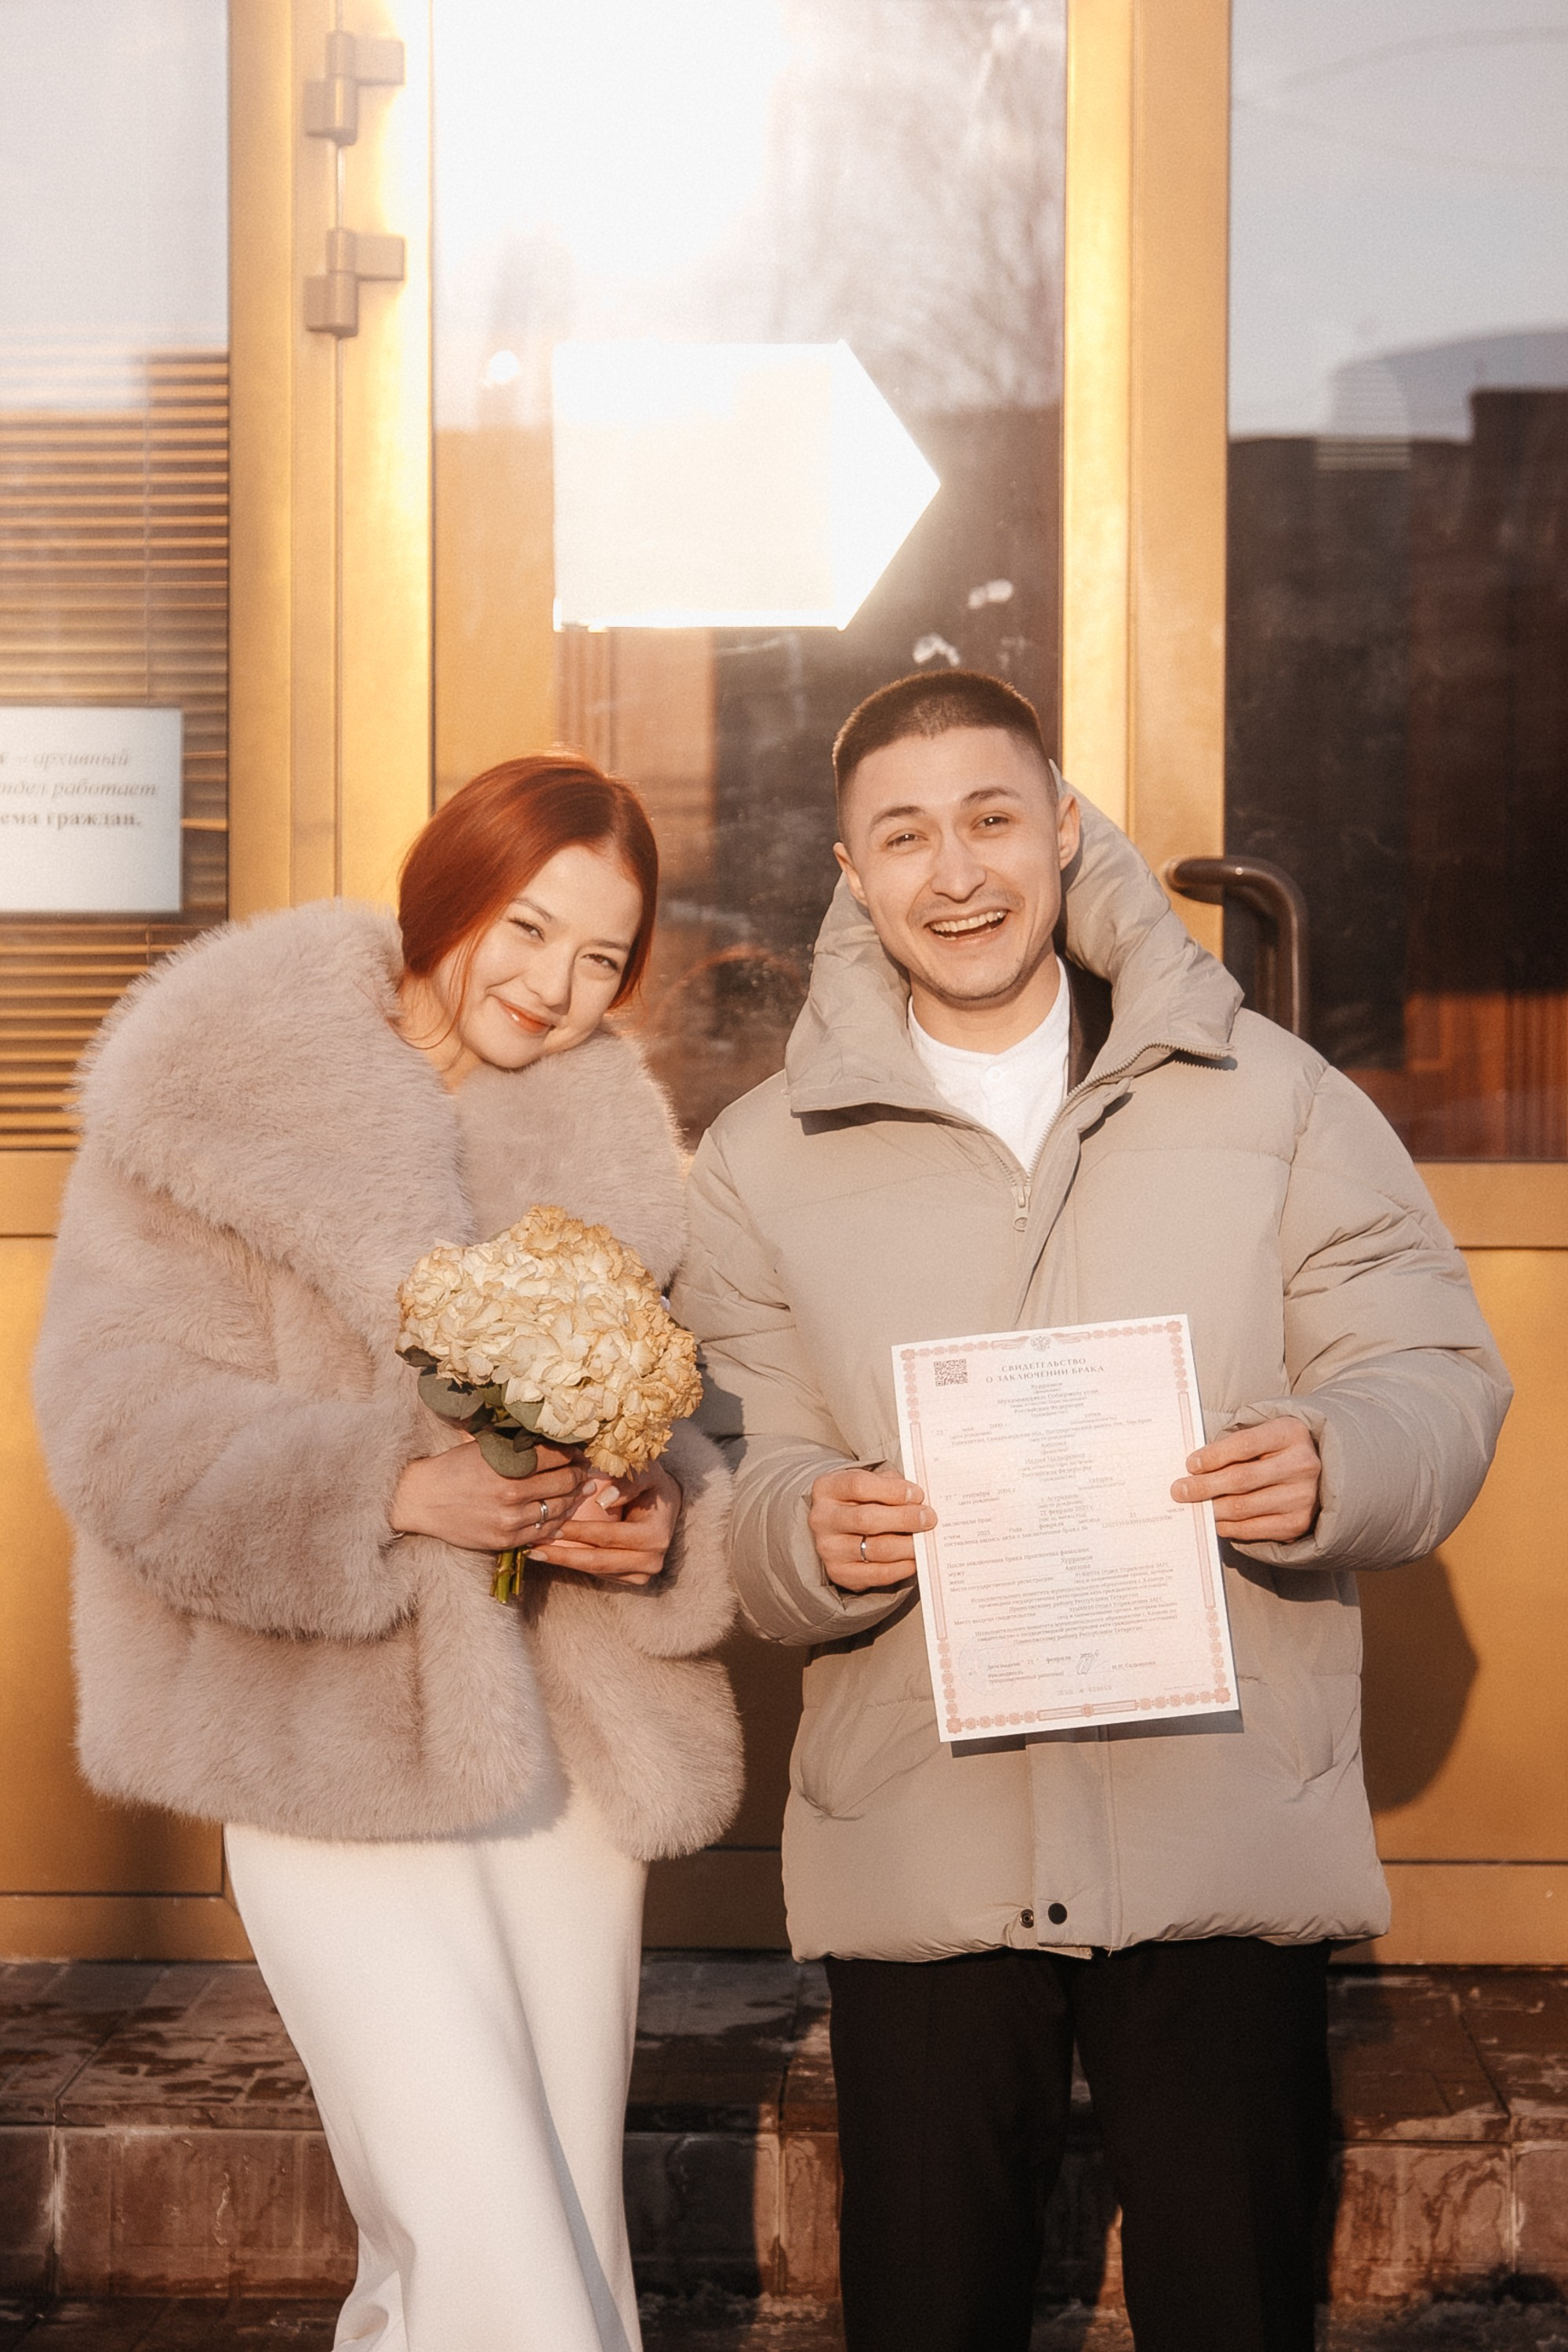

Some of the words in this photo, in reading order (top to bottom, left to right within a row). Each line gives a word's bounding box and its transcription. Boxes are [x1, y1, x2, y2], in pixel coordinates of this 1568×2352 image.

[52, 778, 157, 800] работает
[45, 811, 142, 830] граждан.
[996, 1368, 1068, 1382] ЗАКЛЮЧЕНИИ
[1072, 1364, 1104, 1374] БРАКА
[1001, 1357, 1086, 1372] СВИДЕТЕЛЬСТВО
